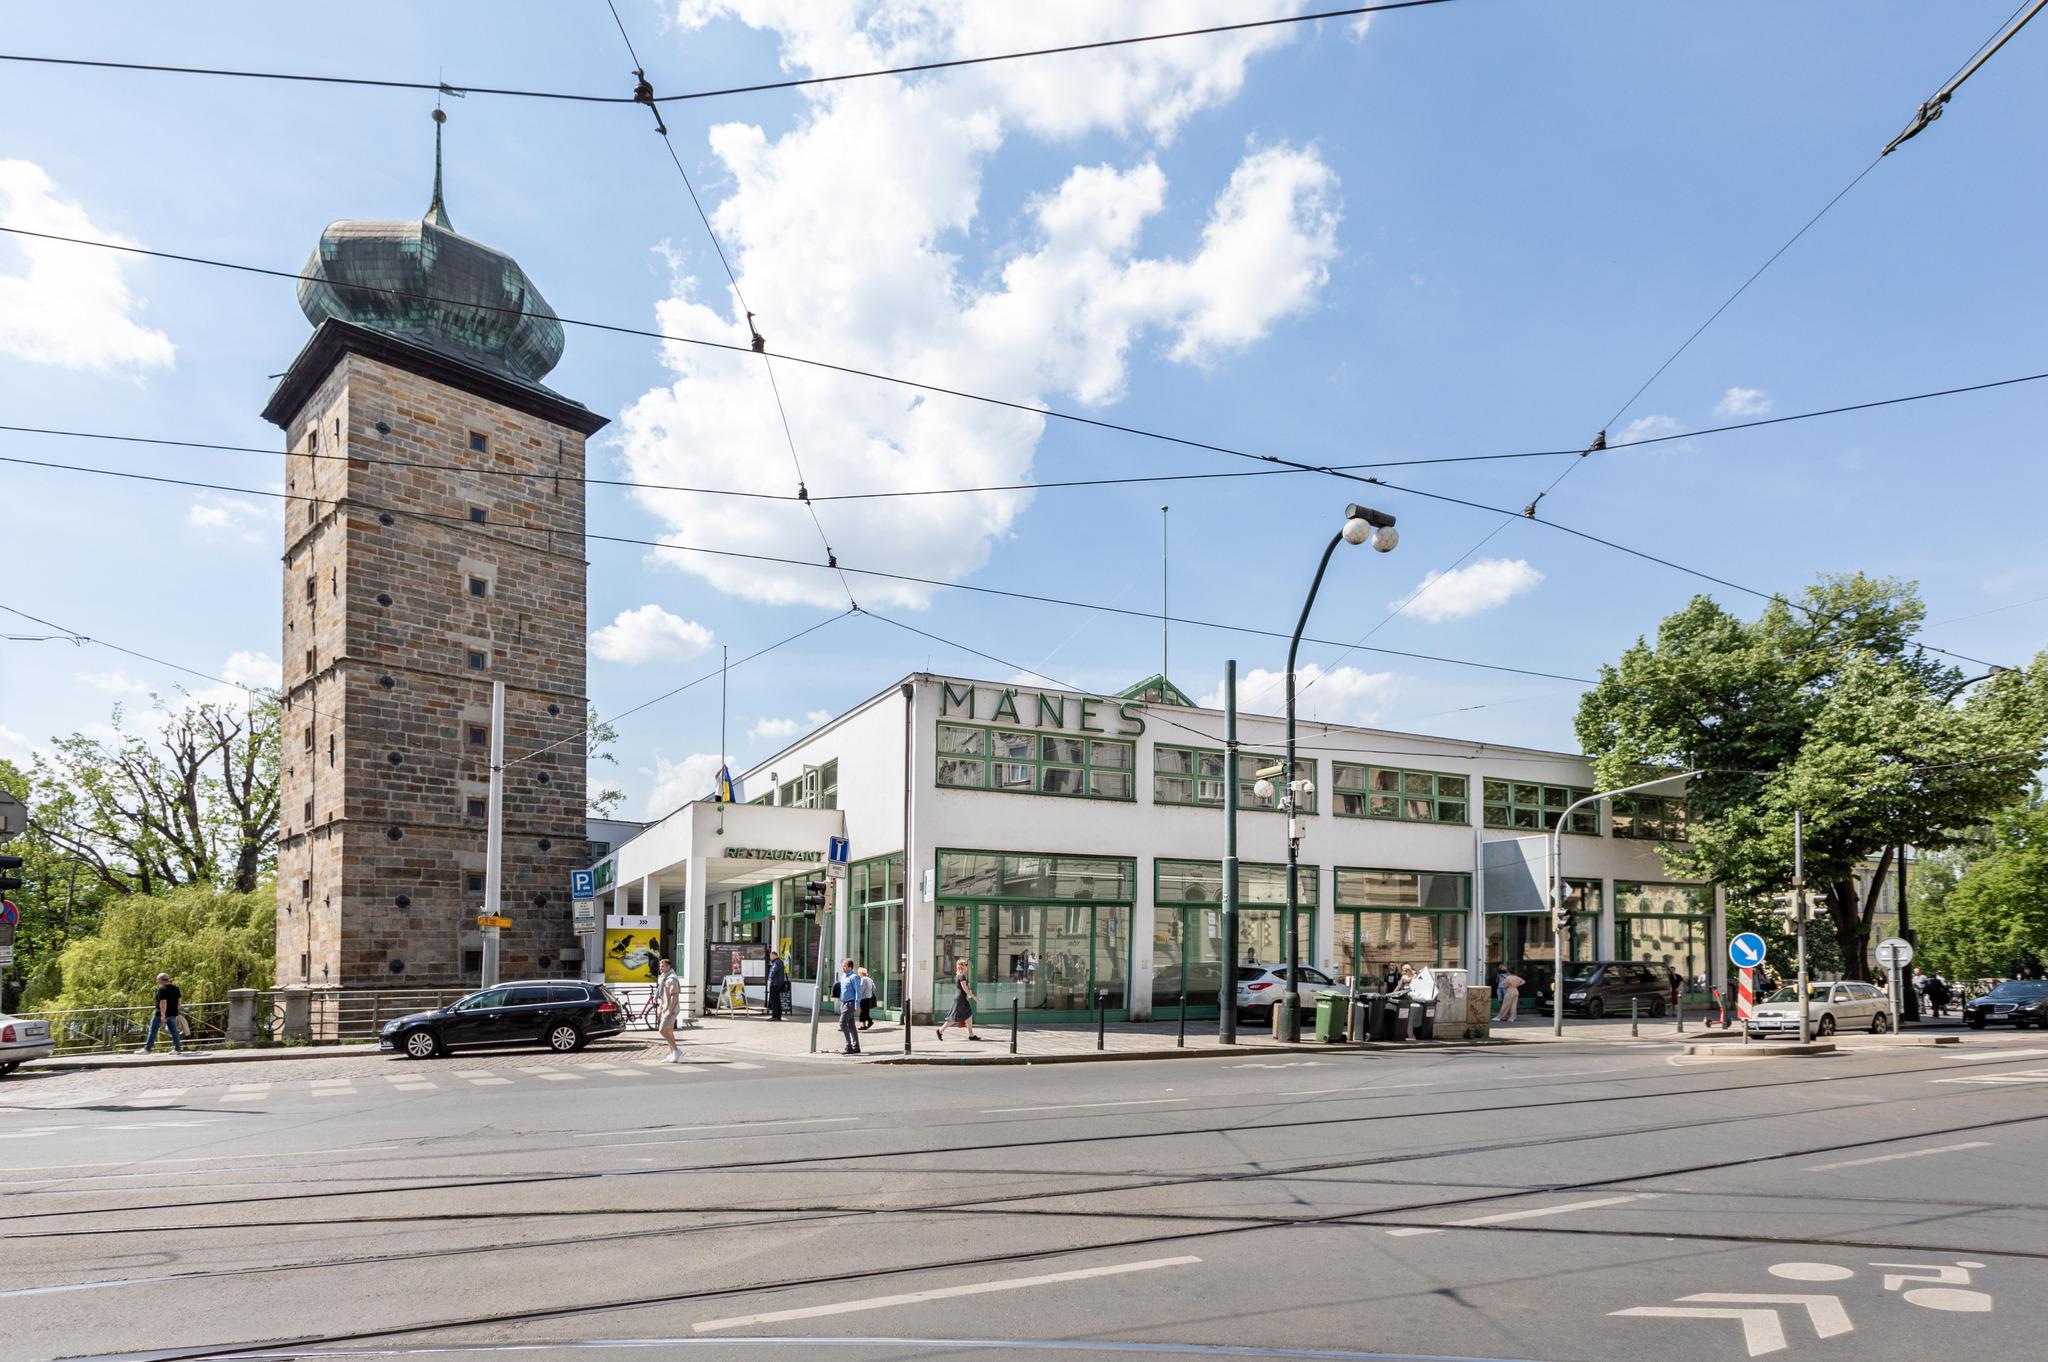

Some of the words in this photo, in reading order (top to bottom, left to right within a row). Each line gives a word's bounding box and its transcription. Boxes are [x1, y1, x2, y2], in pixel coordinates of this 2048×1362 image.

[939, 680, 1146, 737] MÁNES
[724, 847, 825, 862] RESTAURANT
[576, 873, 590, 891] P
